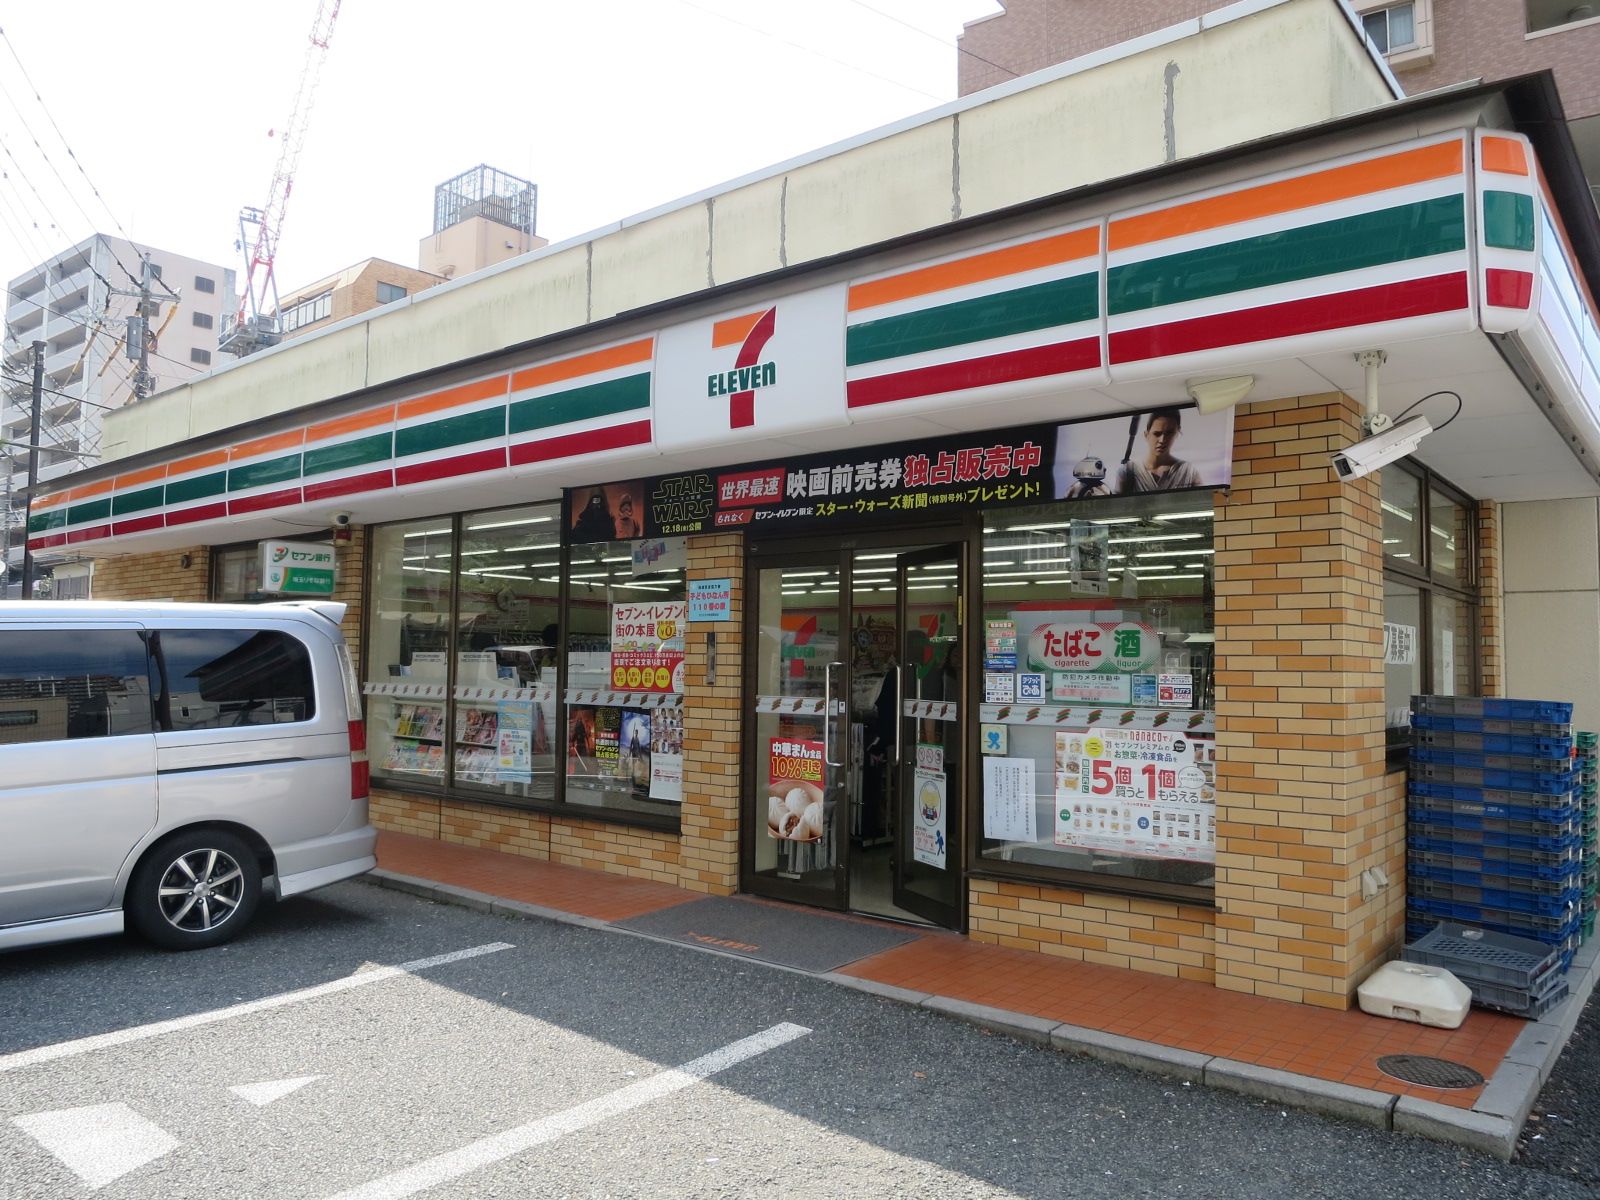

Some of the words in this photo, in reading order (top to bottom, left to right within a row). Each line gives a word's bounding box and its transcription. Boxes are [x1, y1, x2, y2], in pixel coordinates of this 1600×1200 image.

[721, 475, 780, 501] 世界最速
[786, 457, 902, 499] 映画前売券
[903, 441, 1042, 488] 独占販売中
[652, 473, 713, 499] STAR
[652, 499, 713, 523] WARS
[291, 551, 331, 562] セブン銀行
[615, 624, 655, 637] 街の本屋
[1043, 630, 1102, 658] たばこ
[1114, 629, 1141, 658] 酒
[1054, 660, 1090, 668] cigarette
[1116, 660, 1142, 668] liquor
[1061, 674, 1121, 682] 防犯カメラ作動中
[1022, 685, 1040, 696] ぴあ
[1114, 742, 1169, 751] セブンプレミアムの
[772, 757, 821, 779] 10%引き
[1091, 760, 1132, 795] 5個
[1115, 786, 1145, 798] 買うと
[1158, 790, 1199, 804] もらえる
